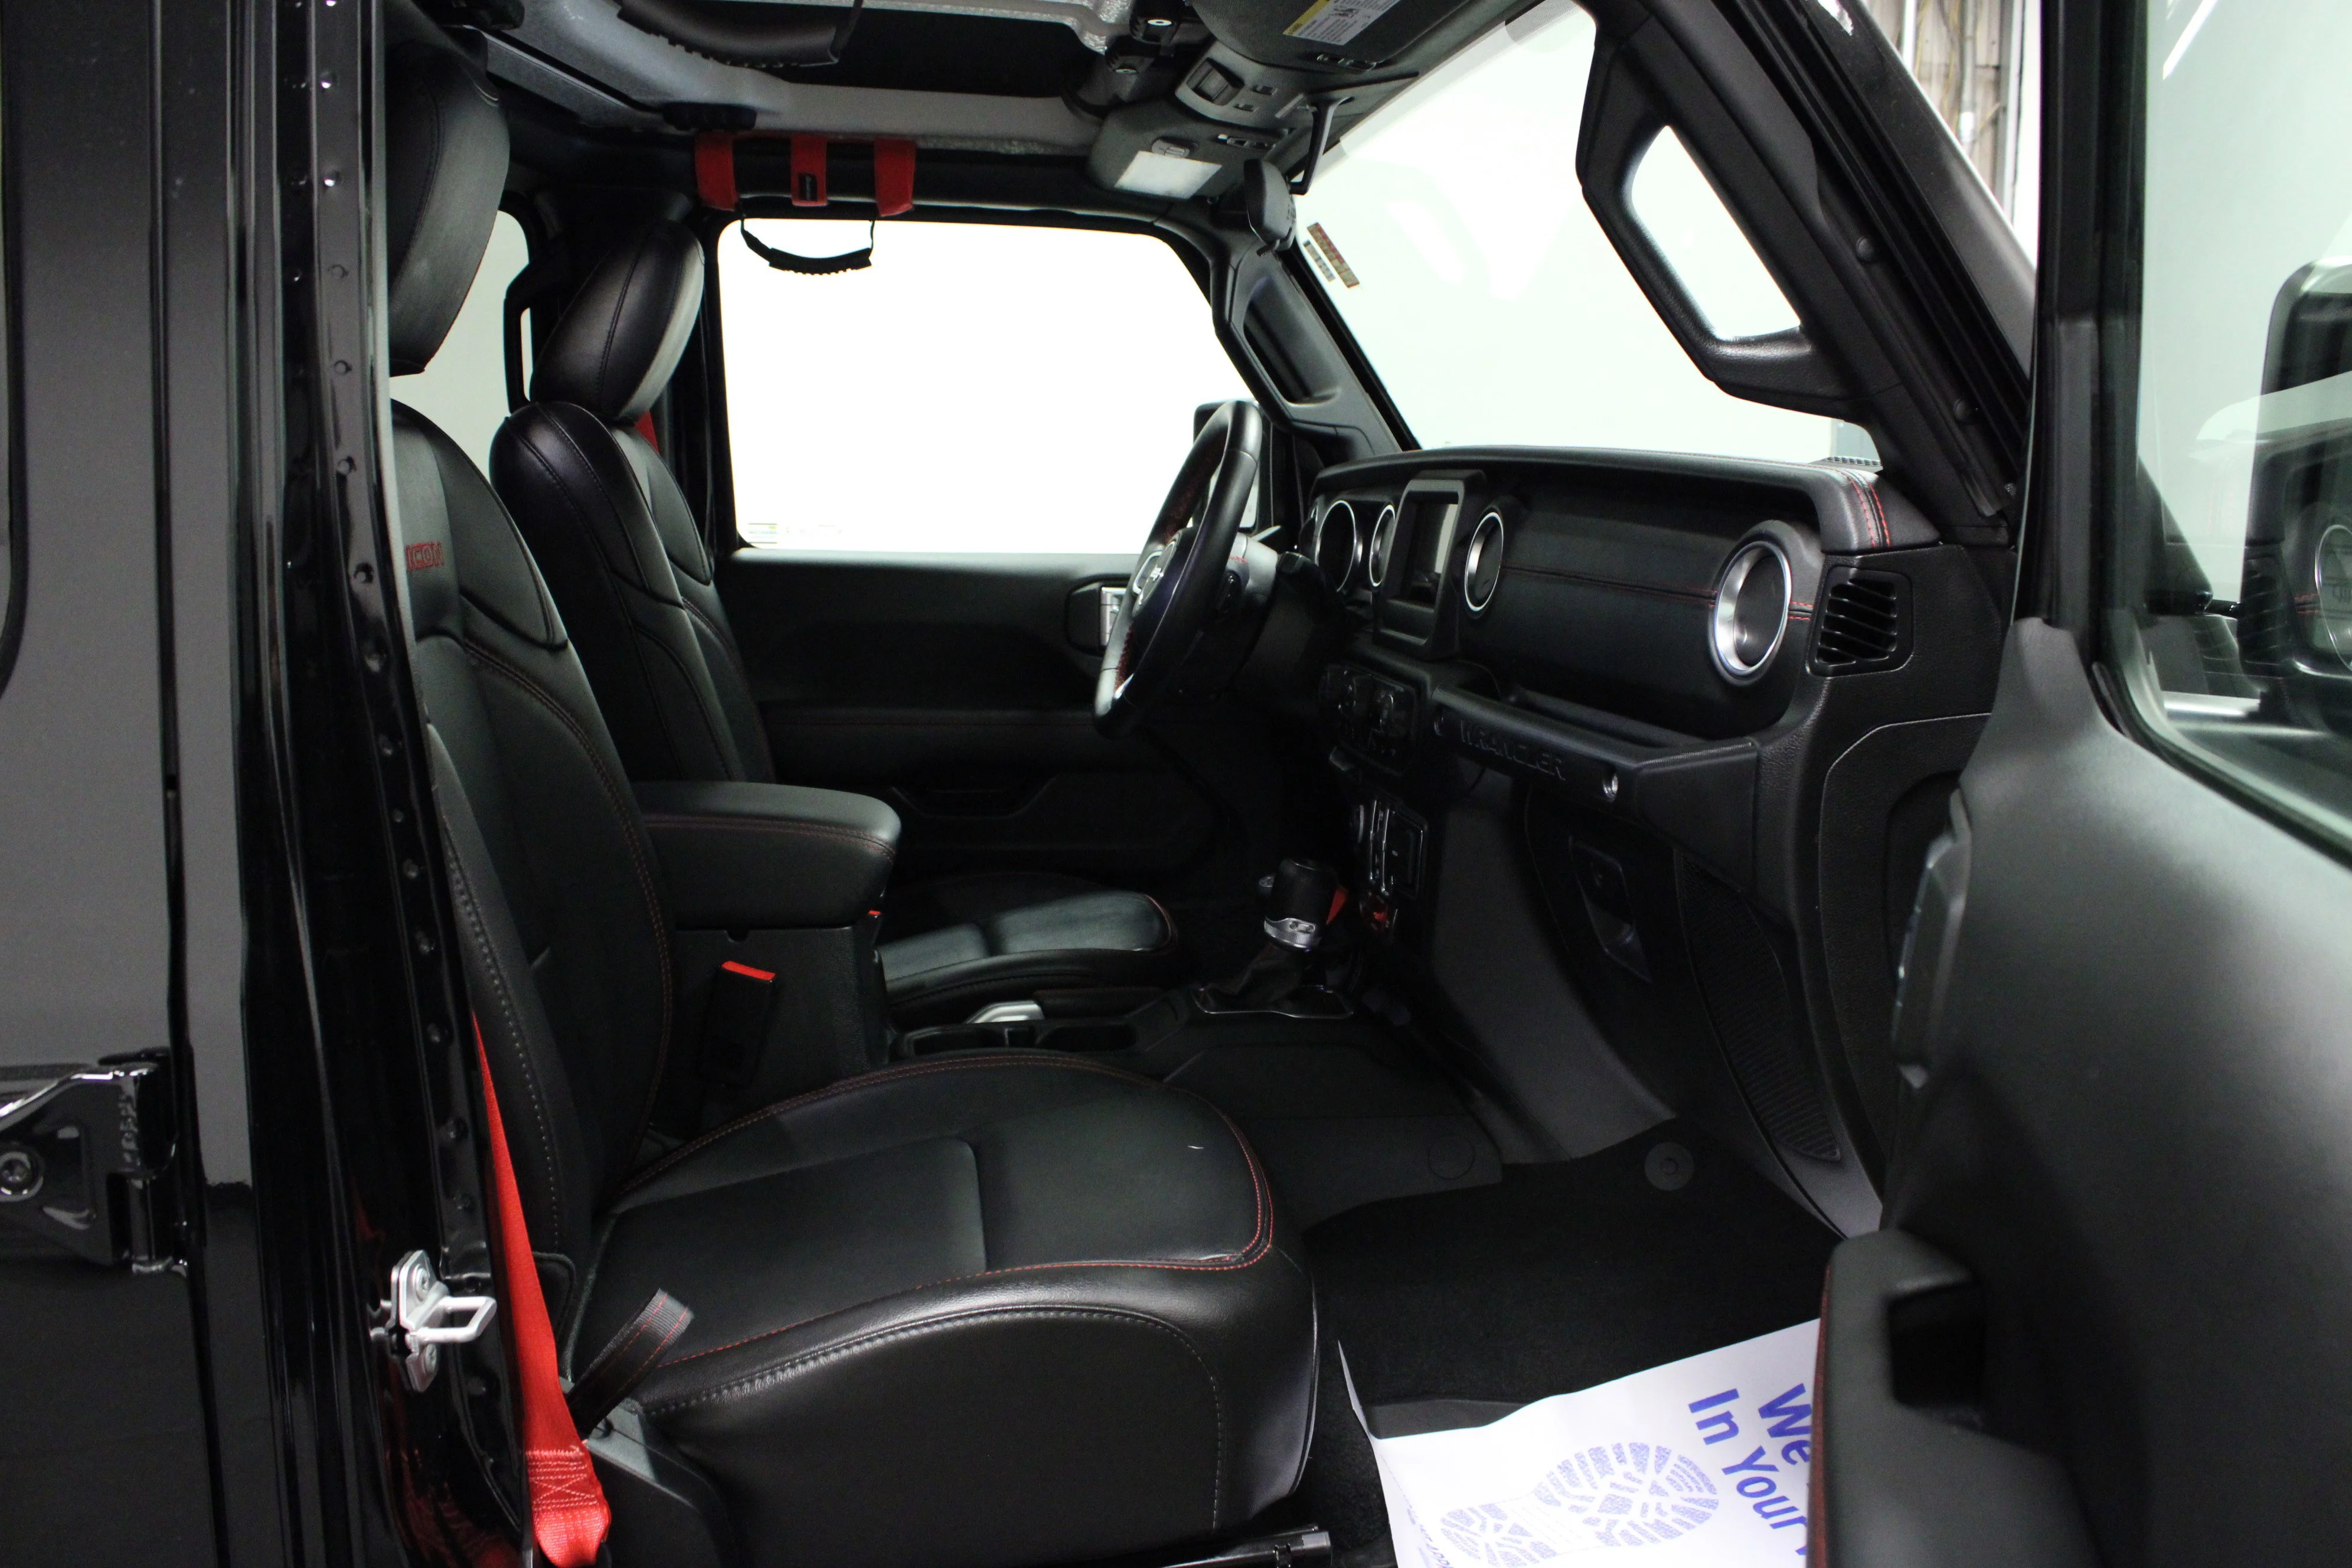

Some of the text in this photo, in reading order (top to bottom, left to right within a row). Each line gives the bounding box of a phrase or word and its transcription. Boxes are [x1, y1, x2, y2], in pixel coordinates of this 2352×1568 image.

[1688, 1389, 1807, 1529] In Your
[1758, 1383, 1812, 1465] We
